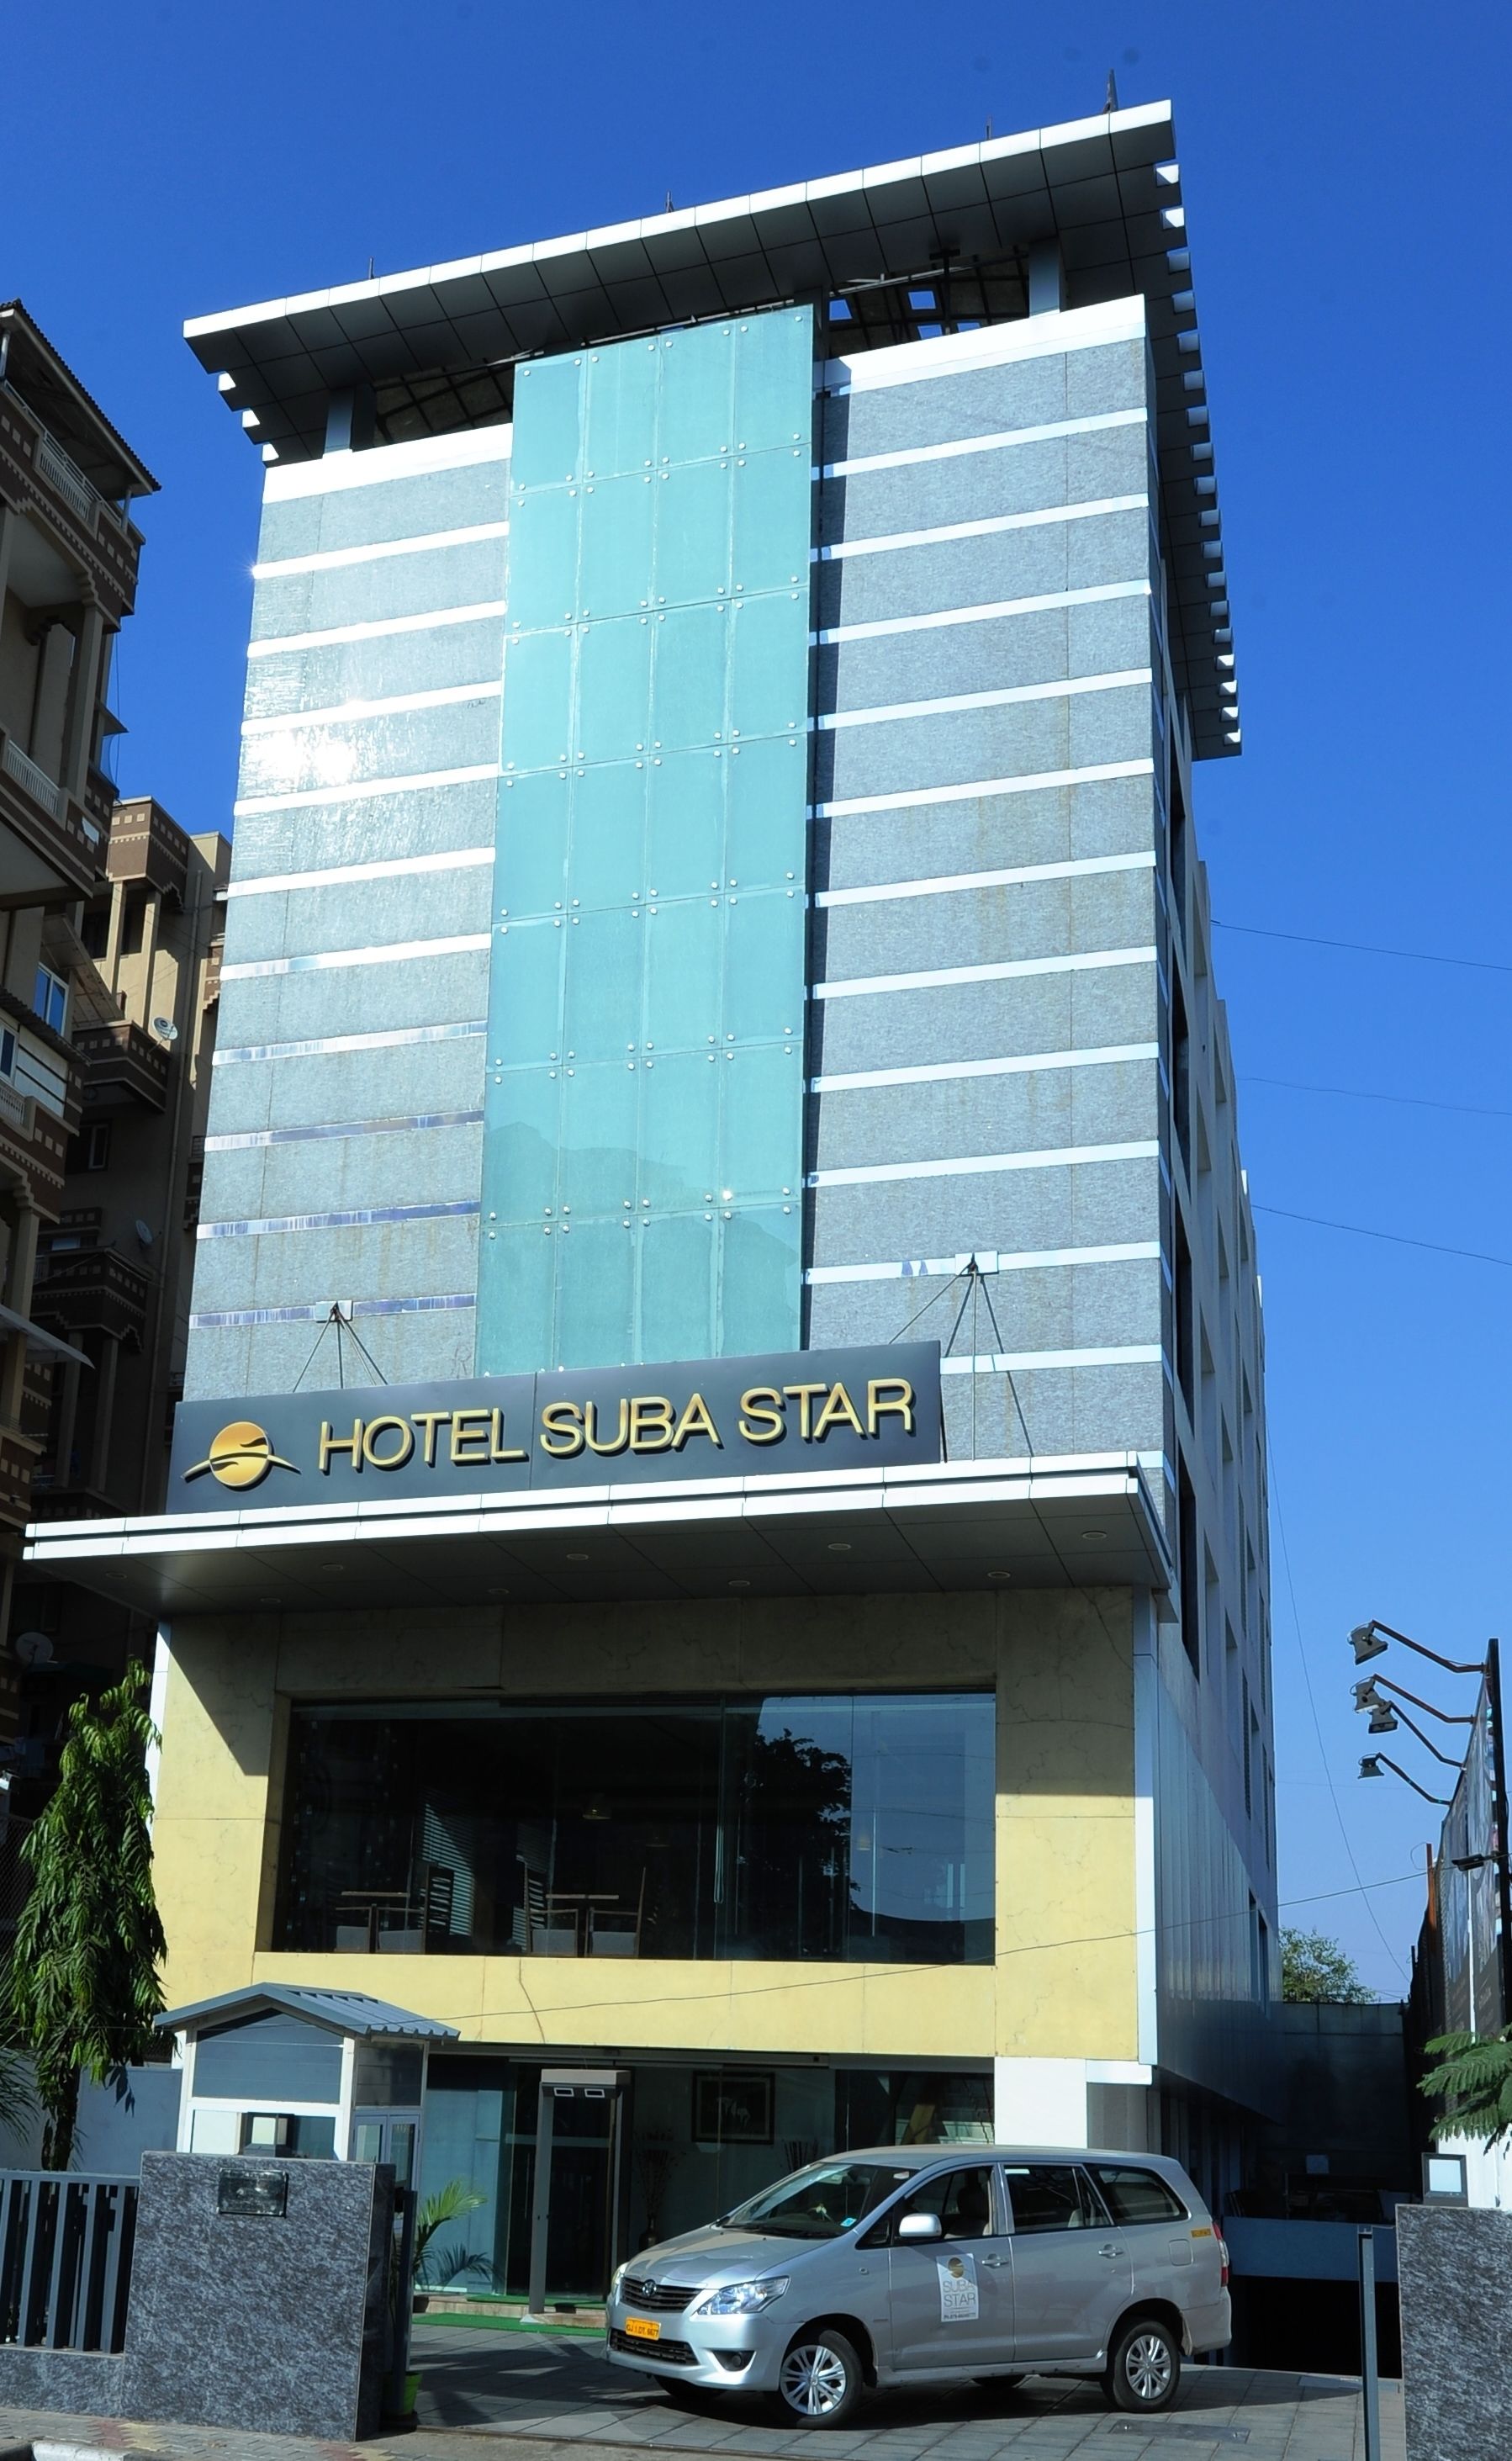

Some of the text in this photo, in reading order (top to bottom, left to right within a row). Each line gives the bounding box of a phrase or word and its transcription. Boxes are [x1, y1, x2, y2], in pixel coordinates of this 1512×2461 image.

[319, 1378, 913, 1471] HOTEL SUBA STAR
[943, 2280, 975, 2293] SUBA
[944, 2293, 975, 2307] STAR
